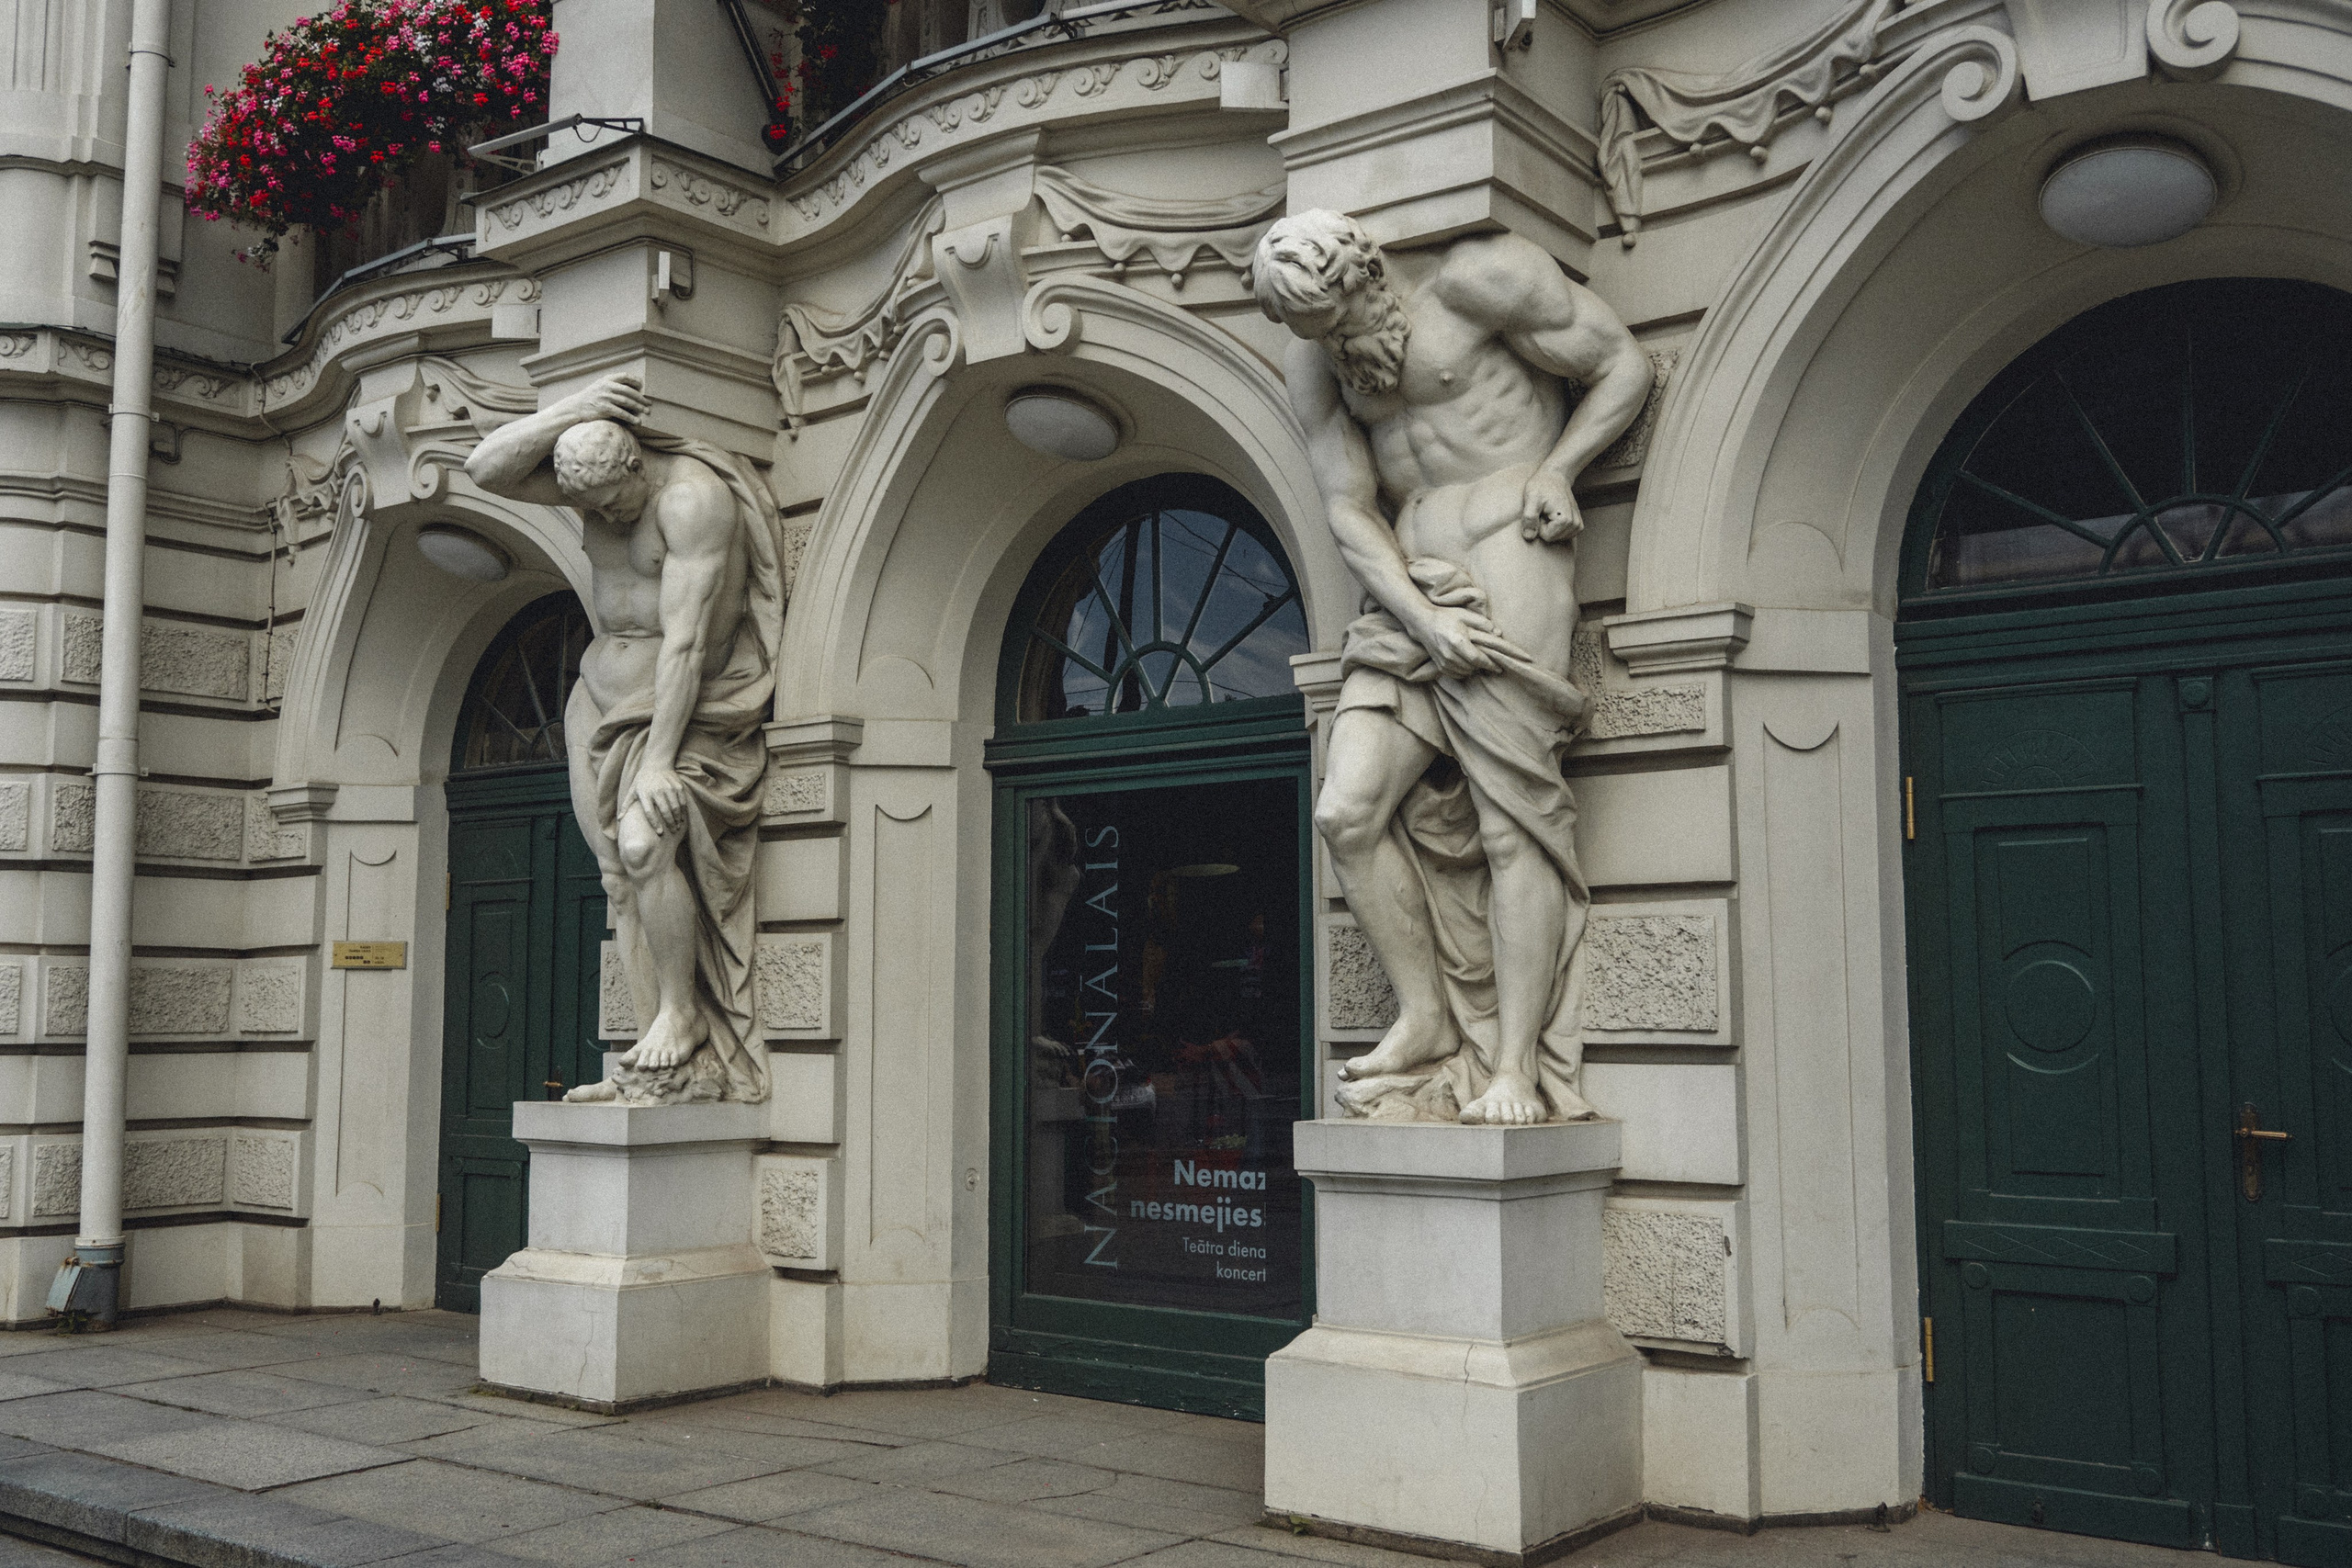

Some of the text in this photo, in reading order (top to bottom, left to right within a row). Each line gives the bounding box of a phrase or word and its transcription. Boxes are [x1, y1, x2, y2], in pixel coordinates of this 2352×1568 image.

[1080, 826, 1118, 1269] NACIONĀLAIS
[1130, 1196, 1267, 1233] nesmejies
[1182, 1236, 1224, 1256] Teātra
